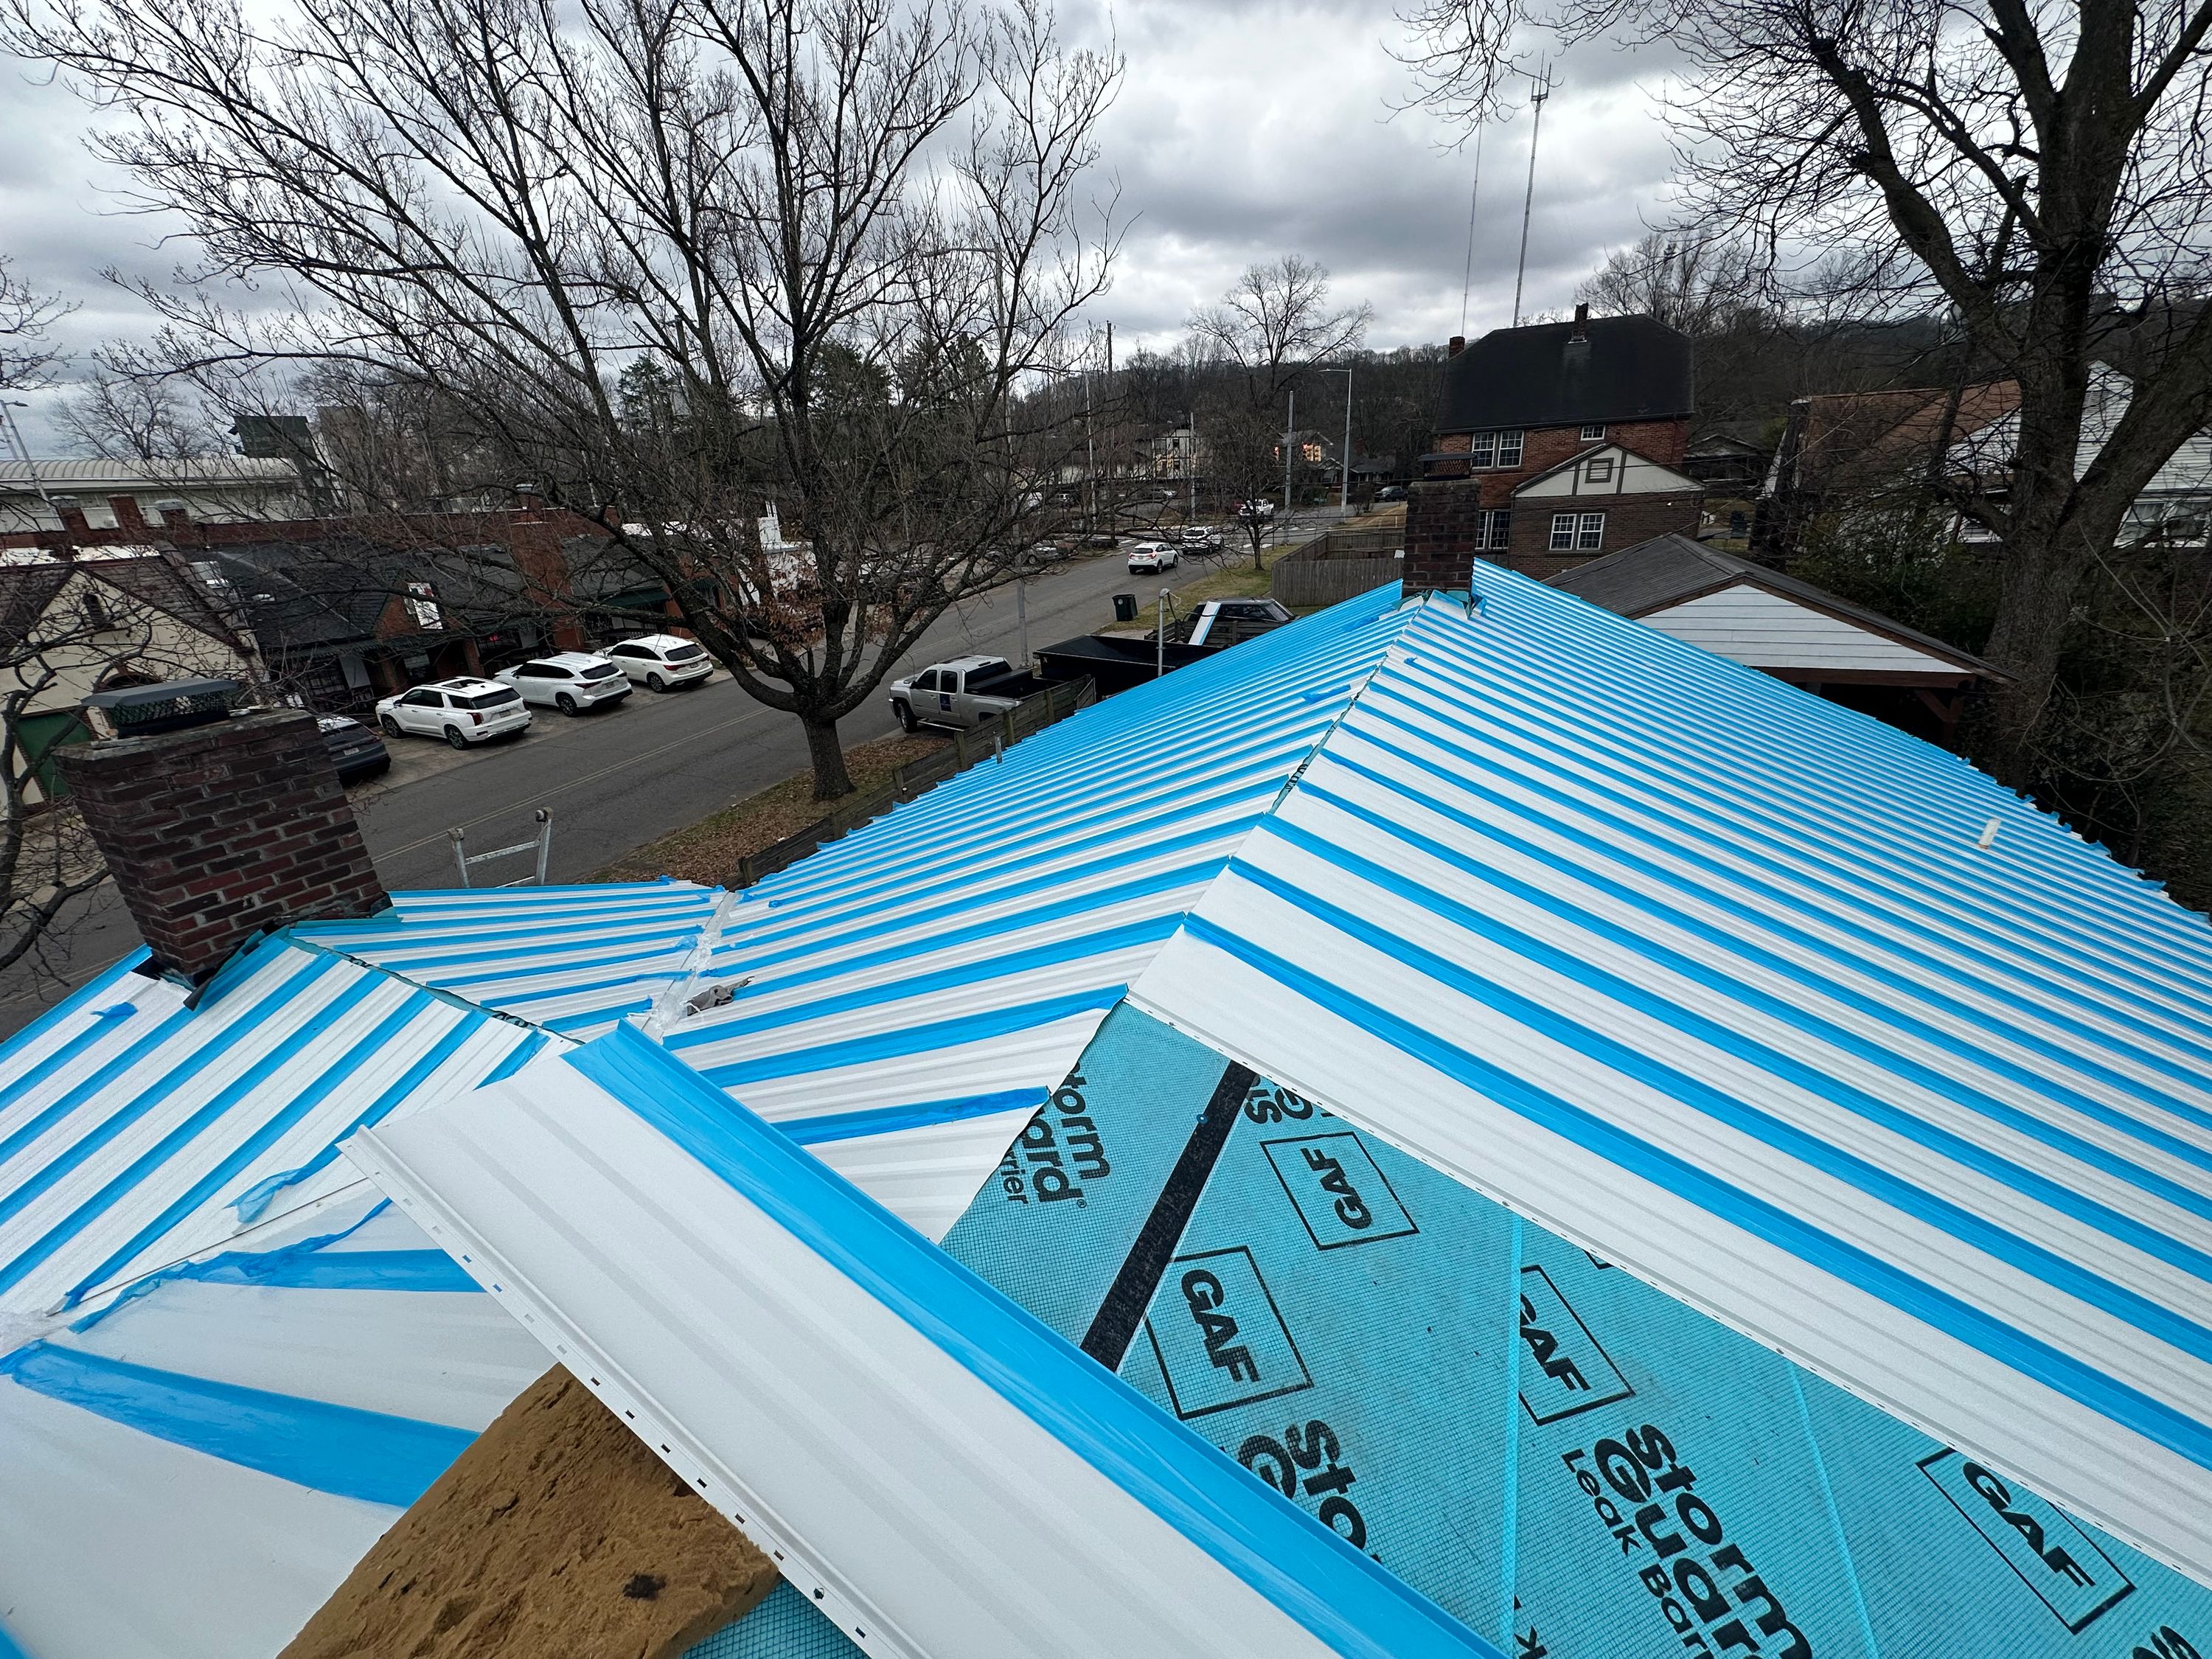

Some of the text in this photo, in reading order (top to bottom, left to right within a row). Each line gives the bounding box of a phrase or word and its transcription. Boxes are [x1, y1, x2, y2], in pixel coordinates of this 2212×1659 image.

[1300, 1147, 1372, 1229] GAF
[1180, 1269, 1261, 1382] GAF
[1284, 1419, 1382, 1564] Sto
[1561, 1448, 1643, 1556] Leak
[1593, 1438, 1764, 1659] Guar
[1625, 1424, 1813, 1659] Storm
[1962, 1461, 2096, 1587] GAF
